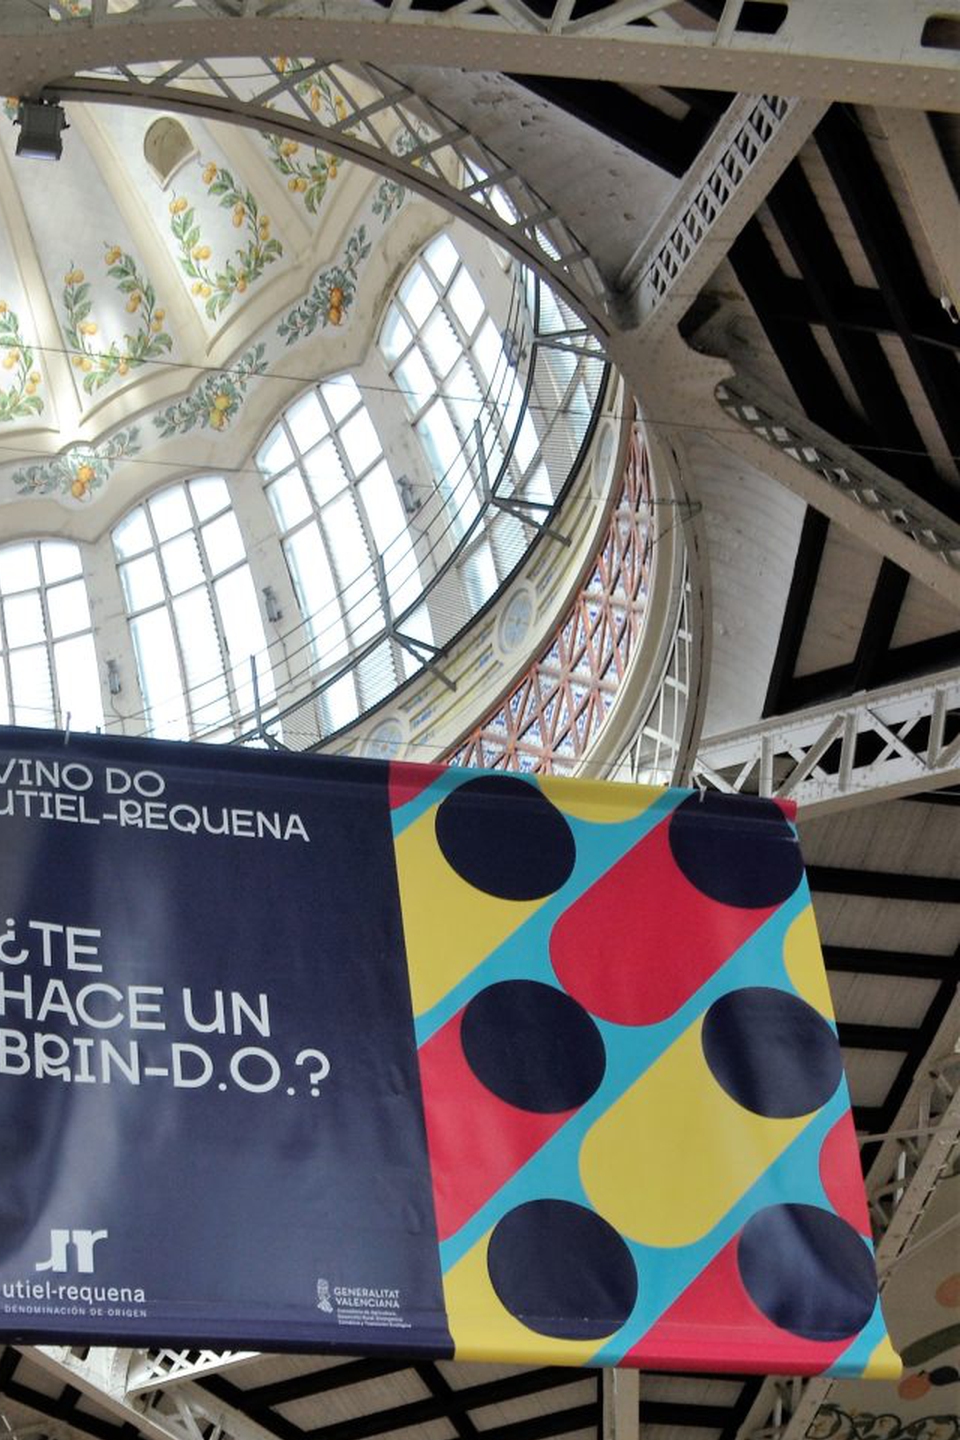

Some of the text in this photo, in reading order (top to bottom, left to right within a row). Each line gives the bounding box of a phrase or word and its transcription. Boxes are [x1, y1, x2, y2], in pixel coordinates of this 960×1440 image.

[106, 767, 166, 798] DO
[183, 988, 271, 1037] UN
[3, 1279, 145, 1305] utiel-requena
[333, 1286, 400, 1299] GENERALITAT
[90, 1307, 103, 1316] DE
[107, 1307, 147, 1318] ORIGEN
[335, 1297, 400, 1309] VALENCIANA
